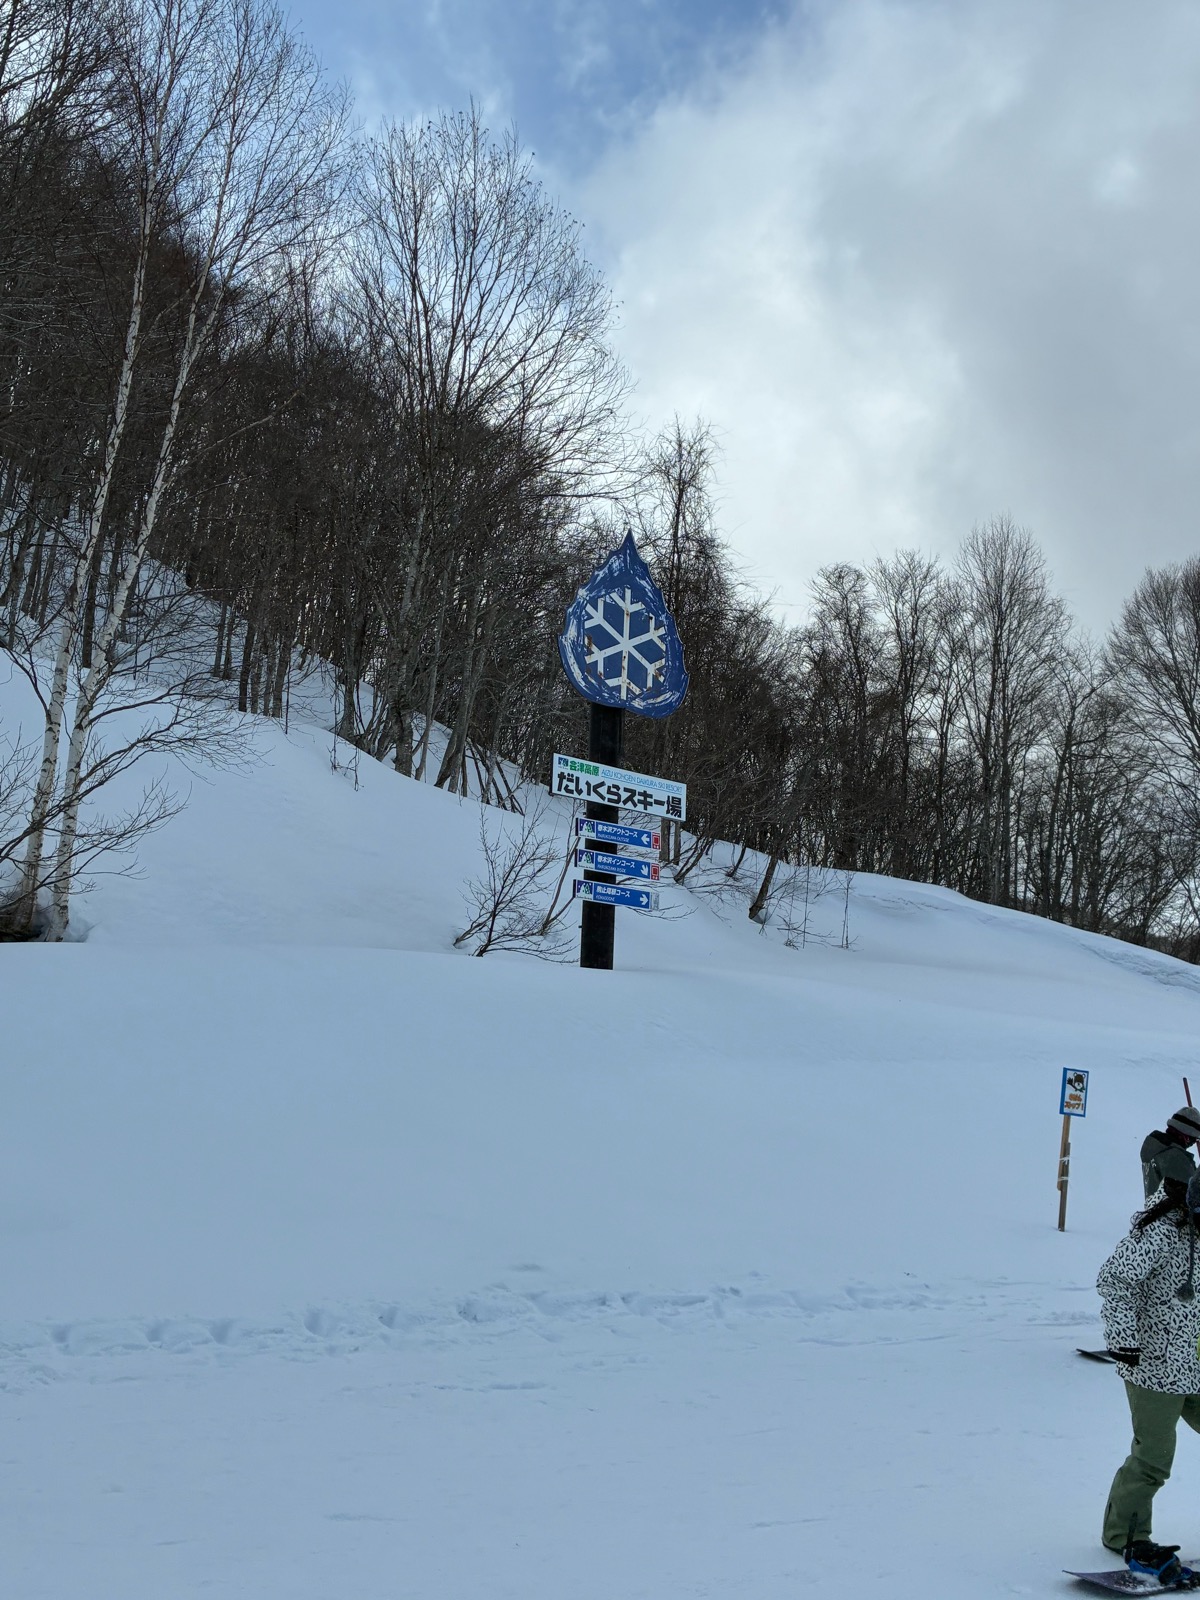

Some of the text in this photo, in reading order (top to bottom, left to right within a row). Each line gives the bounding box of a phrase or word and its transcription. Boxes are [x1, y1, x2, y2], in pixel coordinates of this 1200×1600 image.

[557, 771, 682, 818] だいくらスキー場
